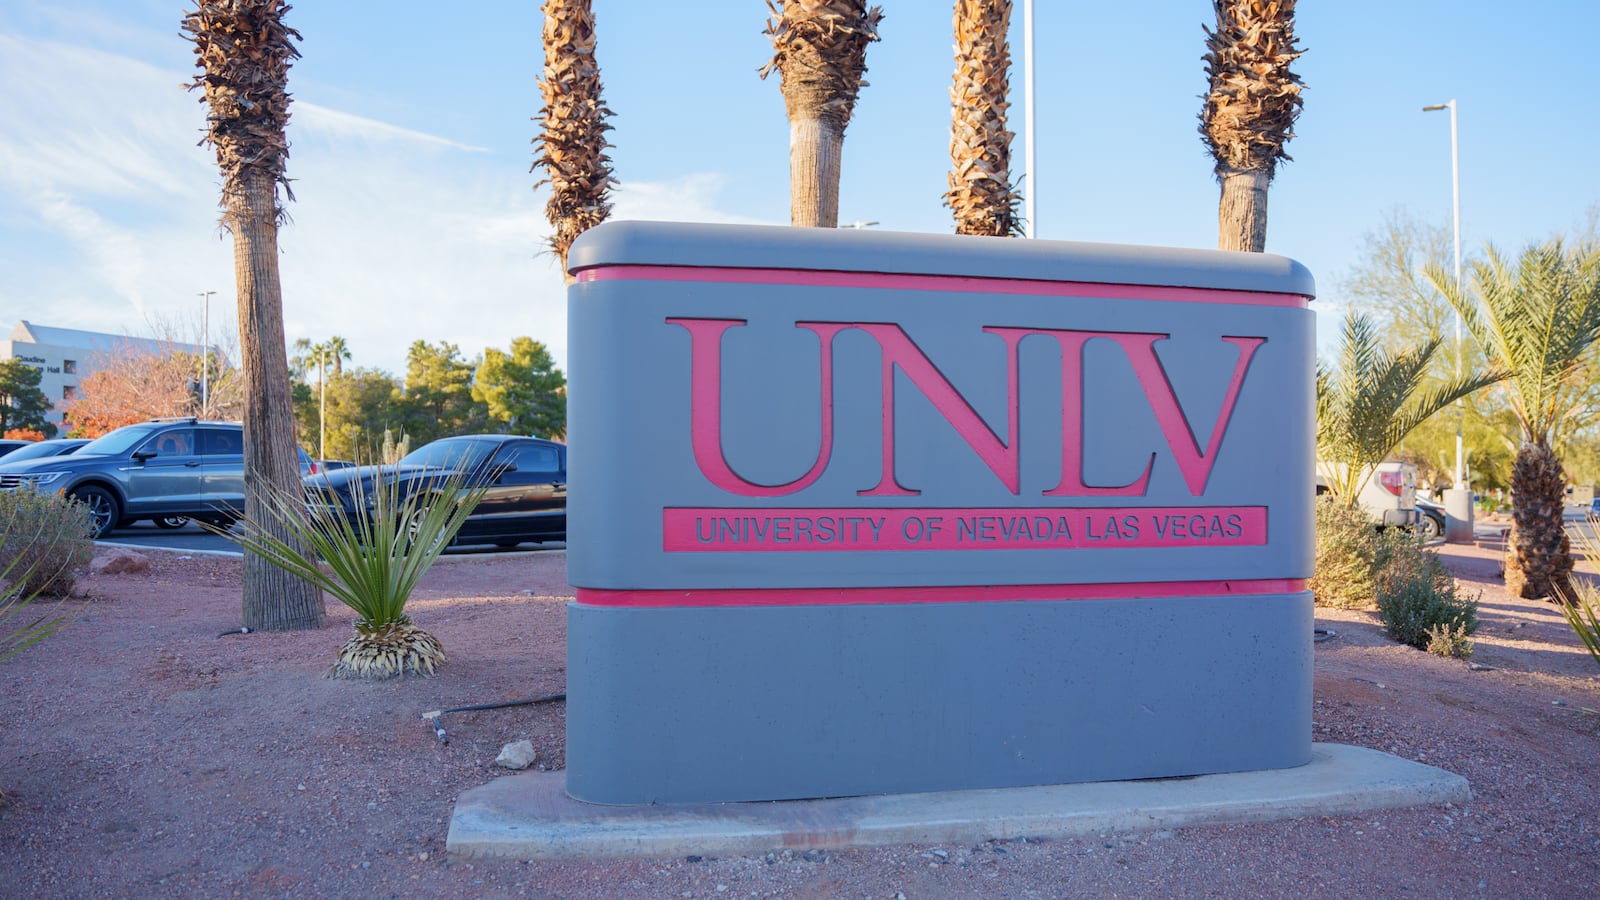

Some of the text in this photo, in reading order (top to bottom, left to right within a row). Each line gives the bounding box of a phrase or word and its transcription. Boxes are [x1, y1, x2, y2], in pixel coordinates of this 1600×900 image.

[47, 366, 60, 374] Hall
[665, 316, 1268, 497] UNLV
[696, 514, 1243, 543] UNIVERSITY OF NEVADA LAS VEGAS
